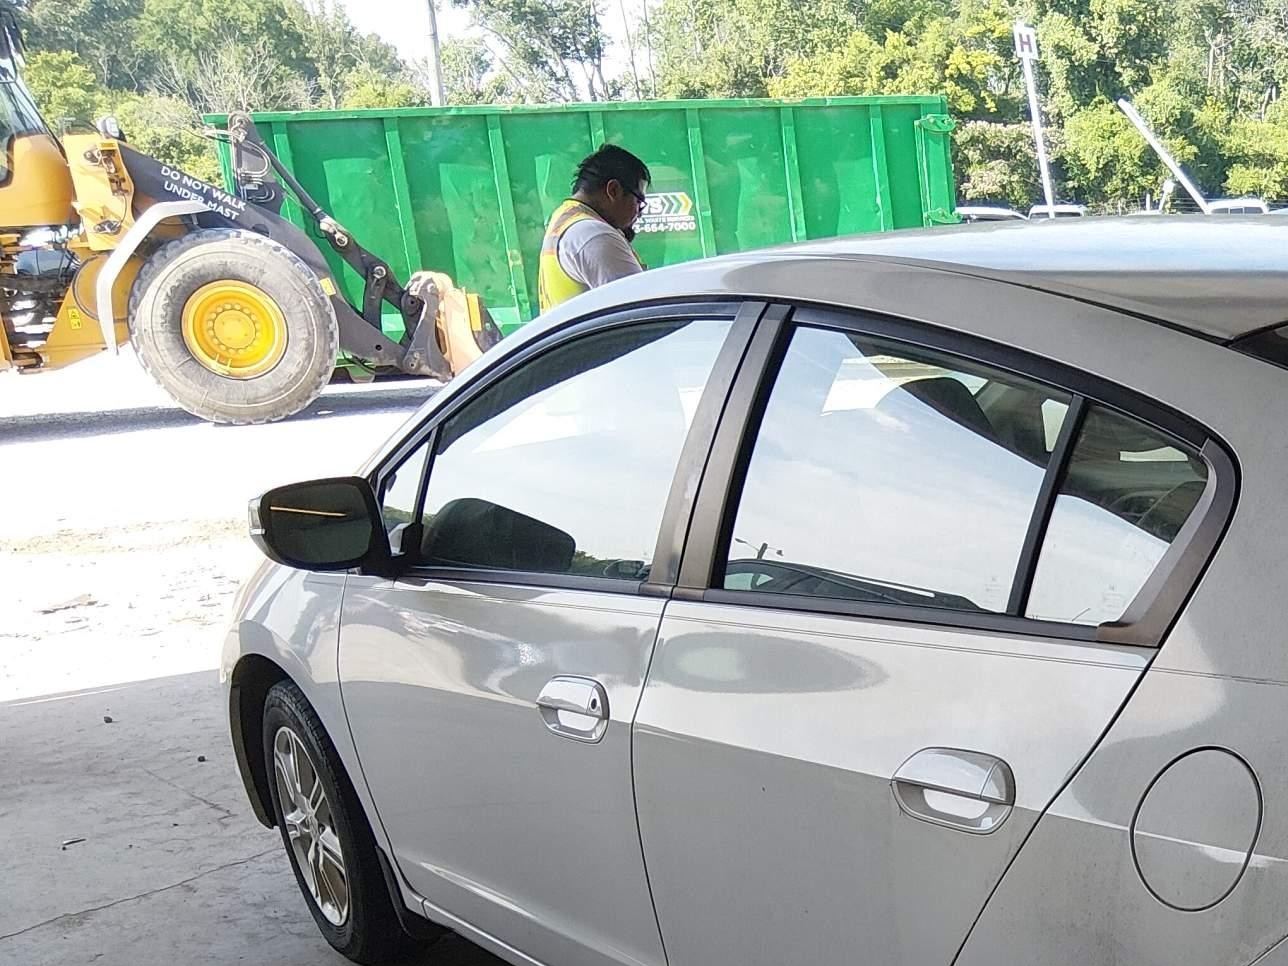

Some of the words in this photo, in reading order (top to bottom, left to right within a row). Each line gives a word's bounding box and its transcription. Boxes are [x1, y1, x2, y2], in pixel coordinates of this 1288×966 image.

[1018, 32, 1033, 53] H
[161, 165, 181, 181] DO
[182, 175, 211, 194] NOT
[212, 189, 247, 212] WALK
[207, 201, 239, 220] MAST
